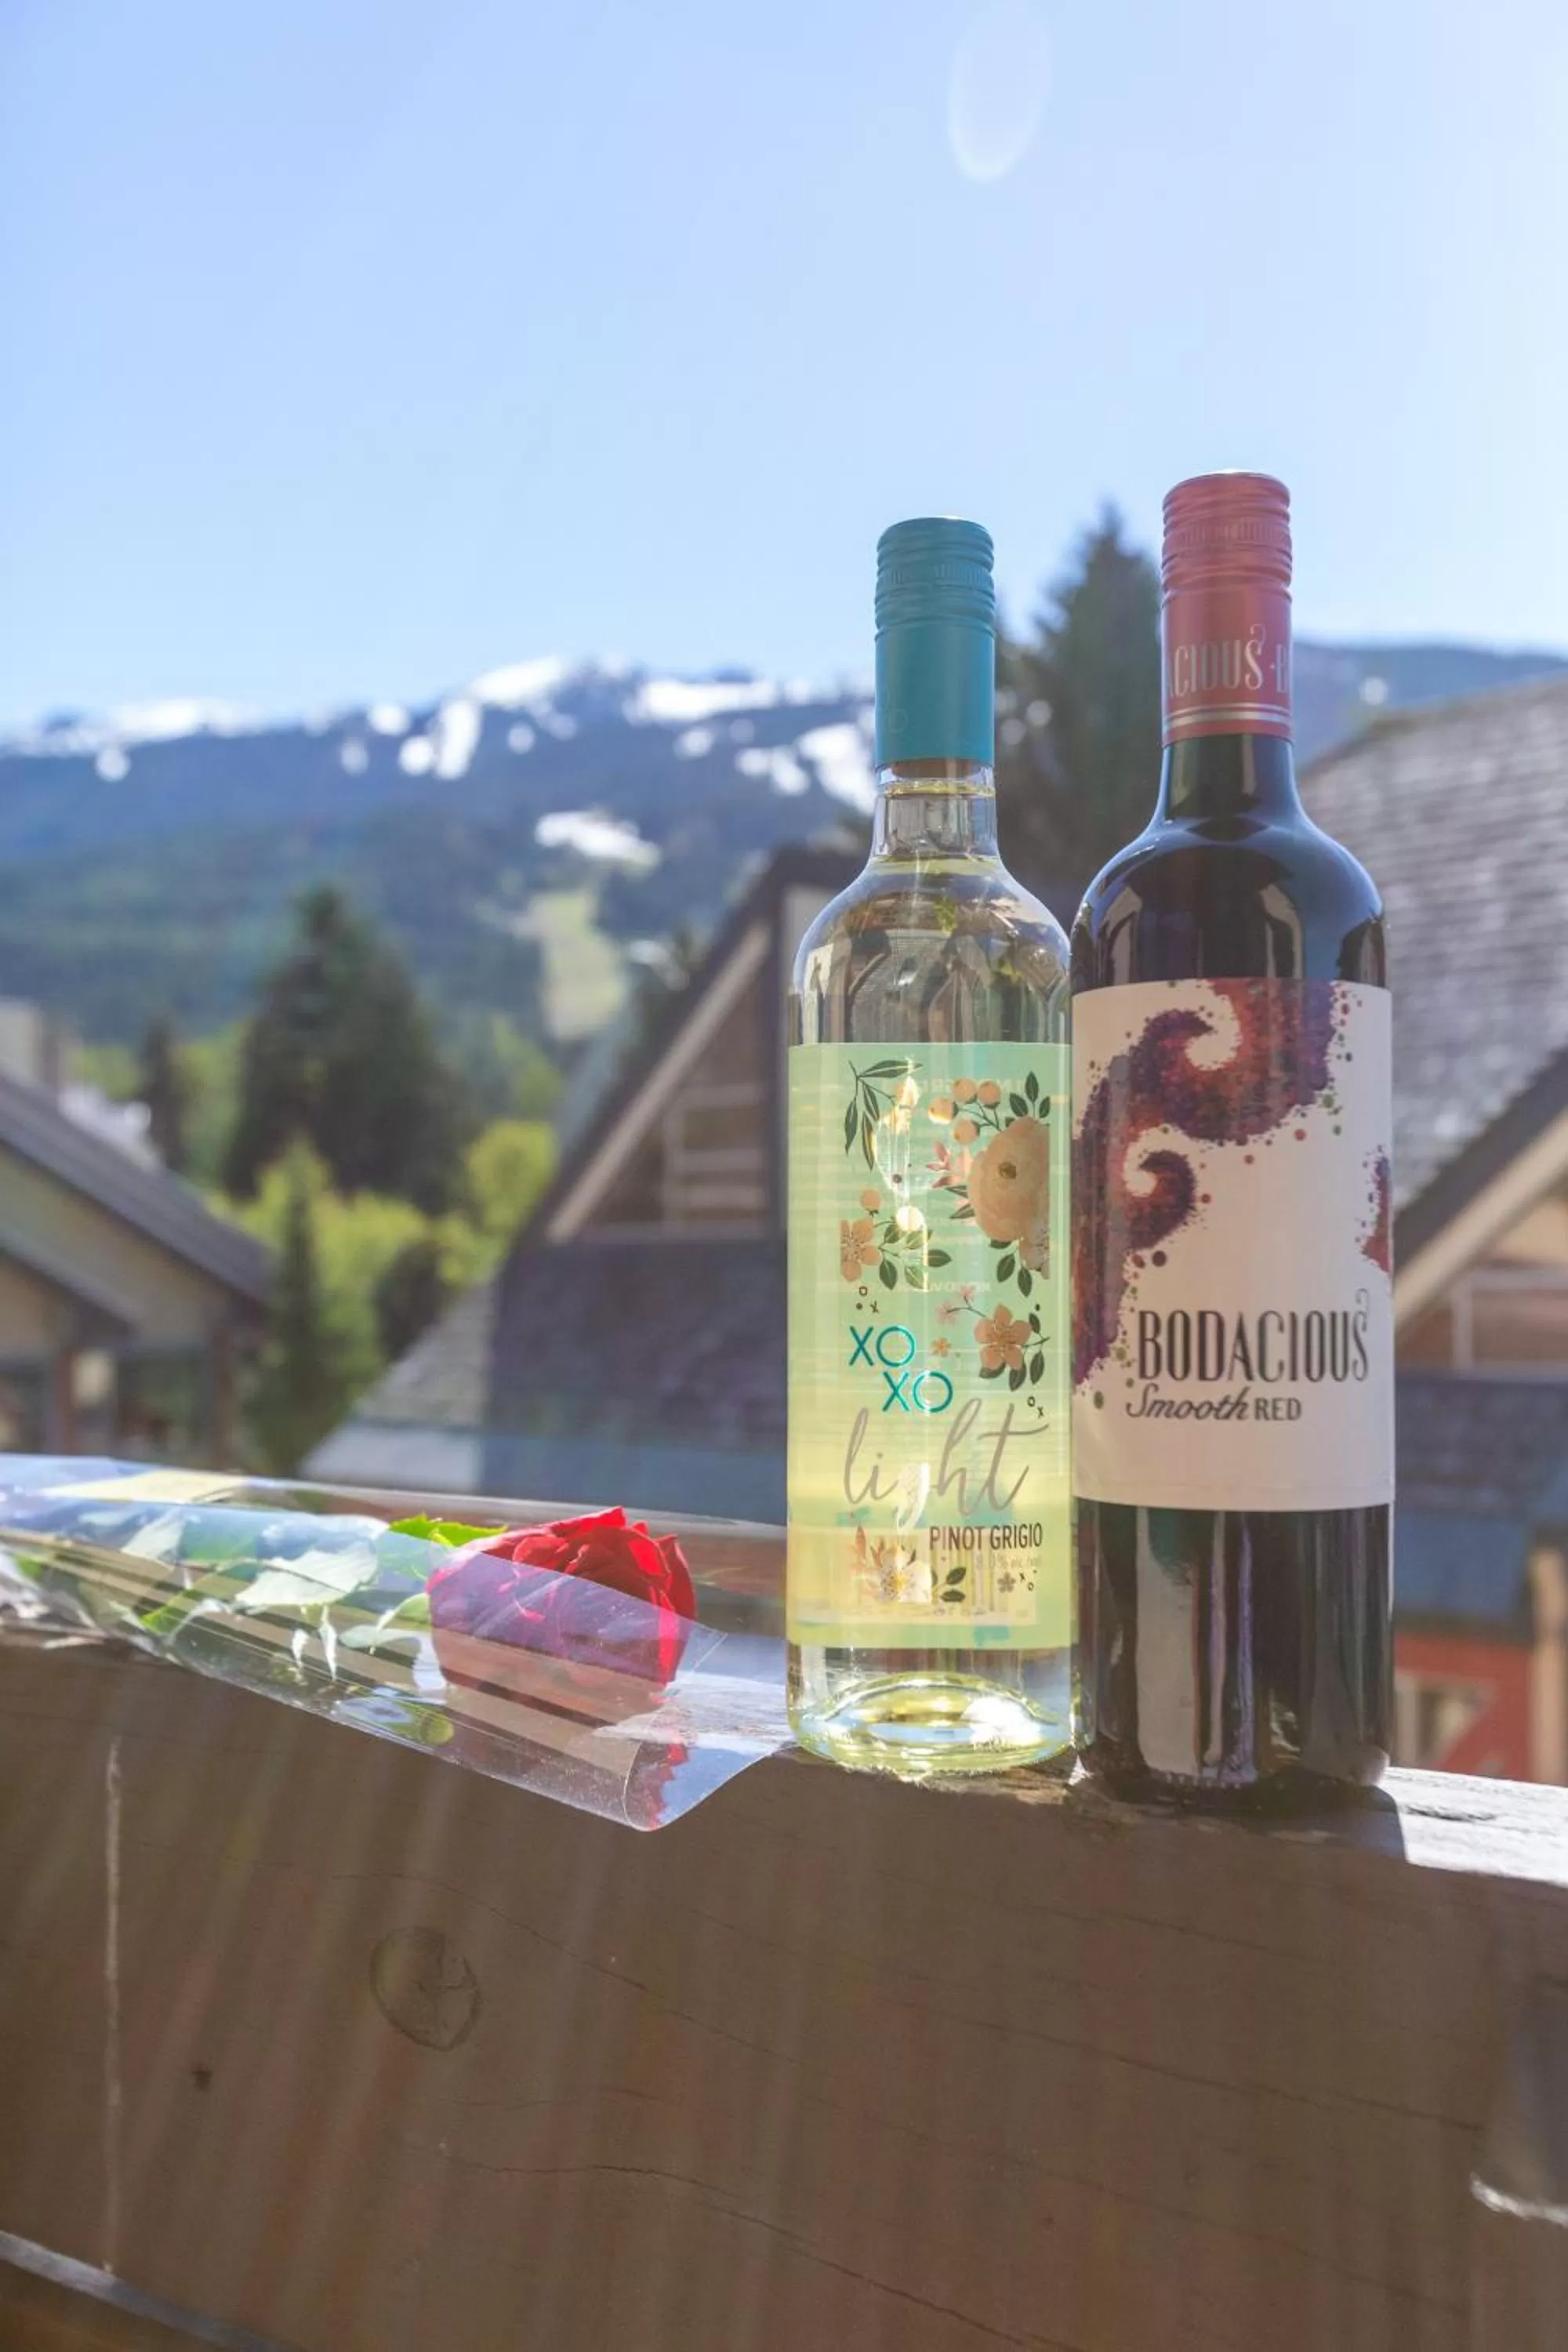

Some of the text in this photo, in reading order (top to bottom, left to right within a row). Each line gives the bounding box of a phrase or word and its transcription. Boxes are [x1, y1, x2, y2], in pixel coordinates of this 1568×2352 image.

[849, 1326, 916, 1367] XO
[1138, 1288, 1370, 1382] BODACIOUS
[882, 1370, 954, 1414] XO
[1126, 1382, 1302, 1421] Smooth RED
[844, 1398, 1051, 1531] light
[929, 1523, 1044, 1551] PINOT GRIGIO
